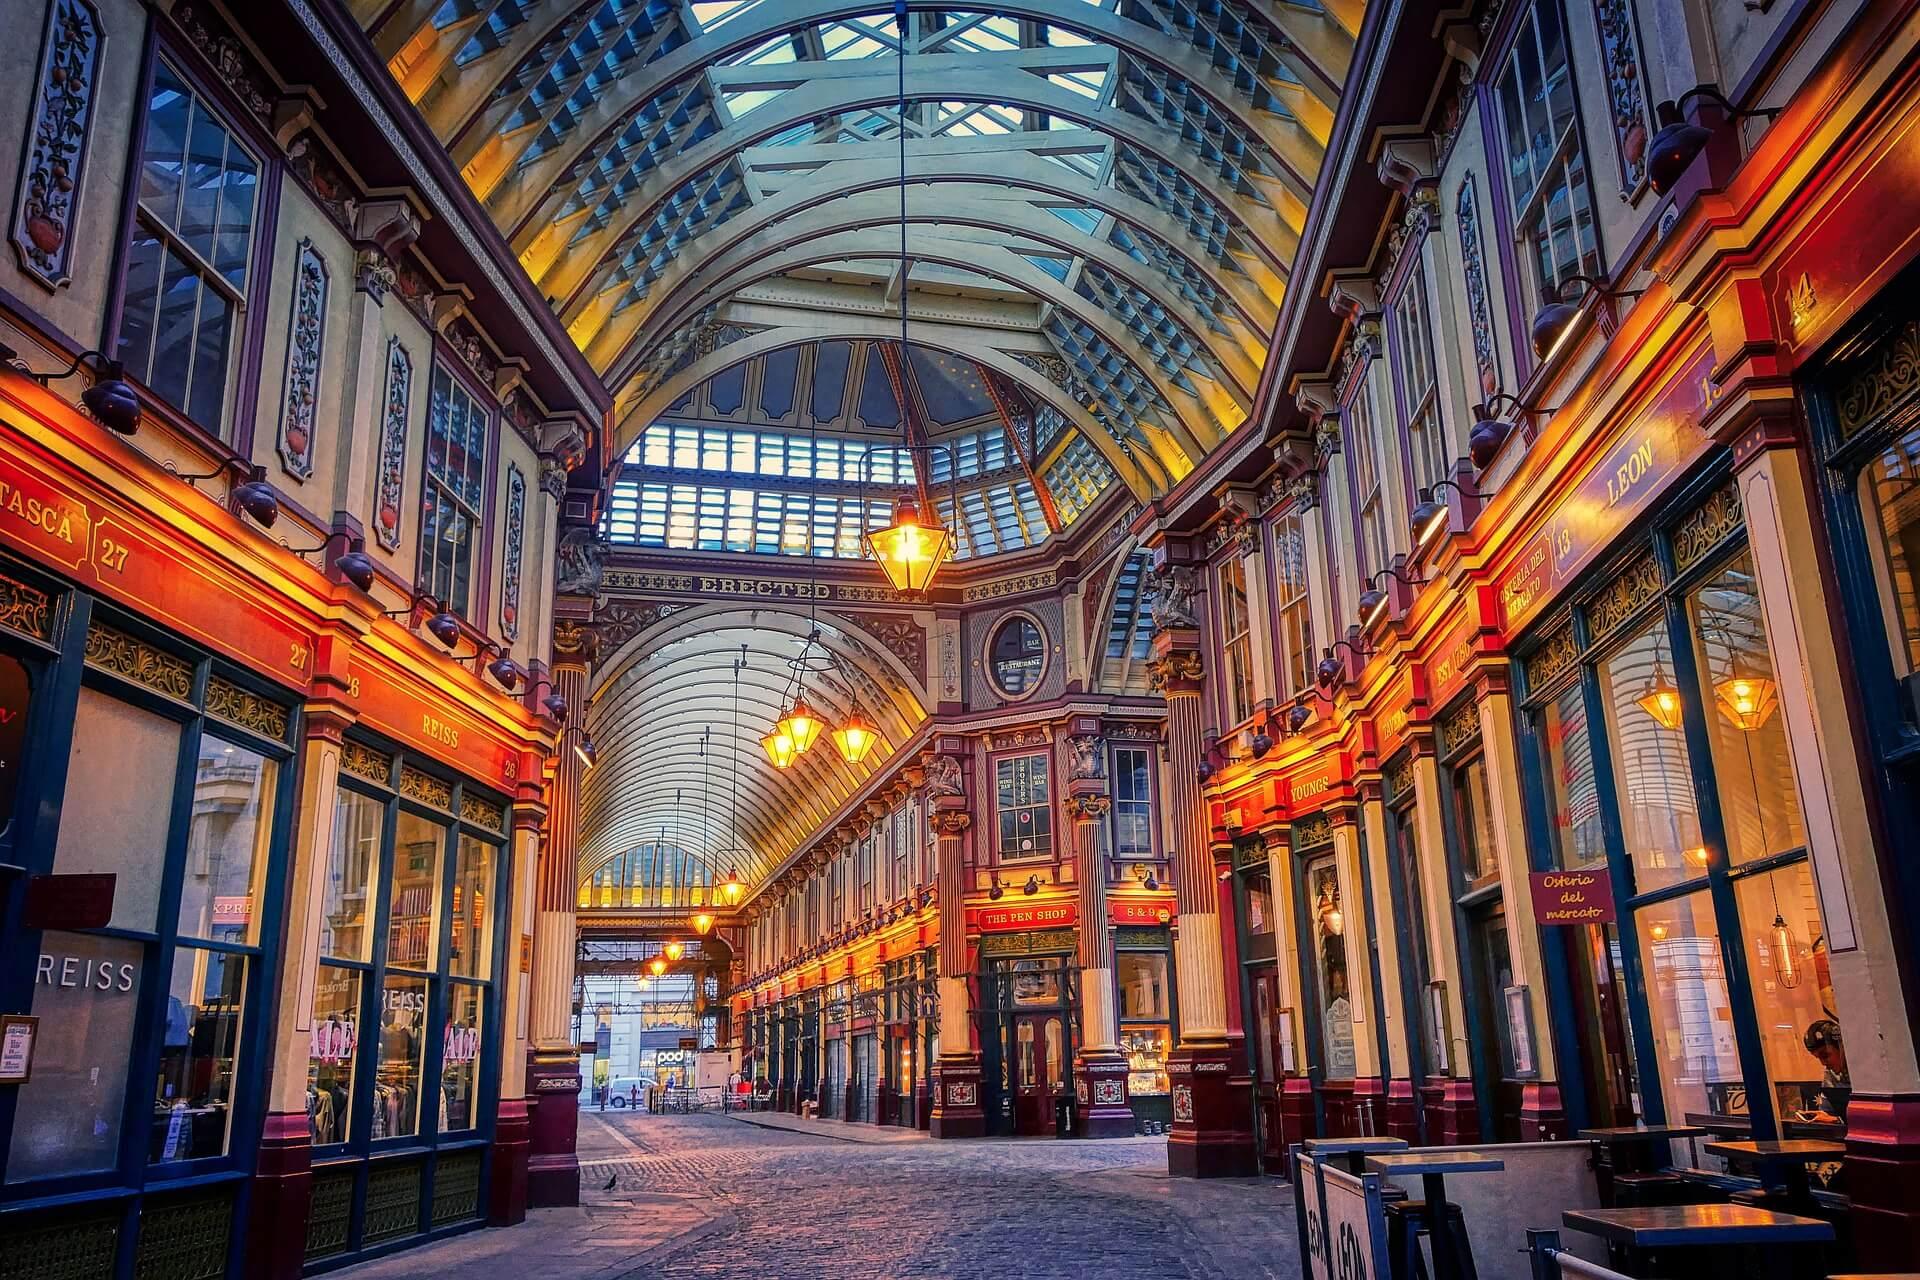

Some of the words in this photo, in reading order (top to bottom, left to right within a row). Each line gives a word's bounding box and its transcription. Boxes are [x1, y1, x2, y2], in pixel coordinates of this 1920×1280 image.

[1607, 437, 1654, 507] LEON
[0, 481, 73, 544] TASCA
[101, 538, 128, 573] 27
[1558, 528, 1570, 560] 13
[700, 576, 830, 599] ERECTED
[1500, 563, 1531, 604] OSTERIA
[1530, 547, 1546, 572] DEL
[289, 643, 308, 670] 27
[1027, 639, 1040, 647] BAR
[1000, 659, 1041, 671] RESTAURANT
[423, 714, 459, 749] REISS
[504, 759, 516, 779] 26
[1291, 775, 1329, 802] YOUNGS
[1543, 873, 1595, 888] Osteria
[1560, 891, 1585, 904] del
[985, 914, 1007, 924] THE
[1010, 911, 1034, 923] PEN
[1037, 908, 1068, 921] SHOP
[1127, 908, 1135, 917] 8
[1137, 908, 1146, 917] &
[1149, 908, 1156, 917] 9
[1546, 906, 1604, 920] mercato
[36, 954, 134, 992] REISS
[310, 1019, 356, 1059] ALE
[444, 1026, 478, 1060] ALE
[657, 1050, 684, 1066] pod
